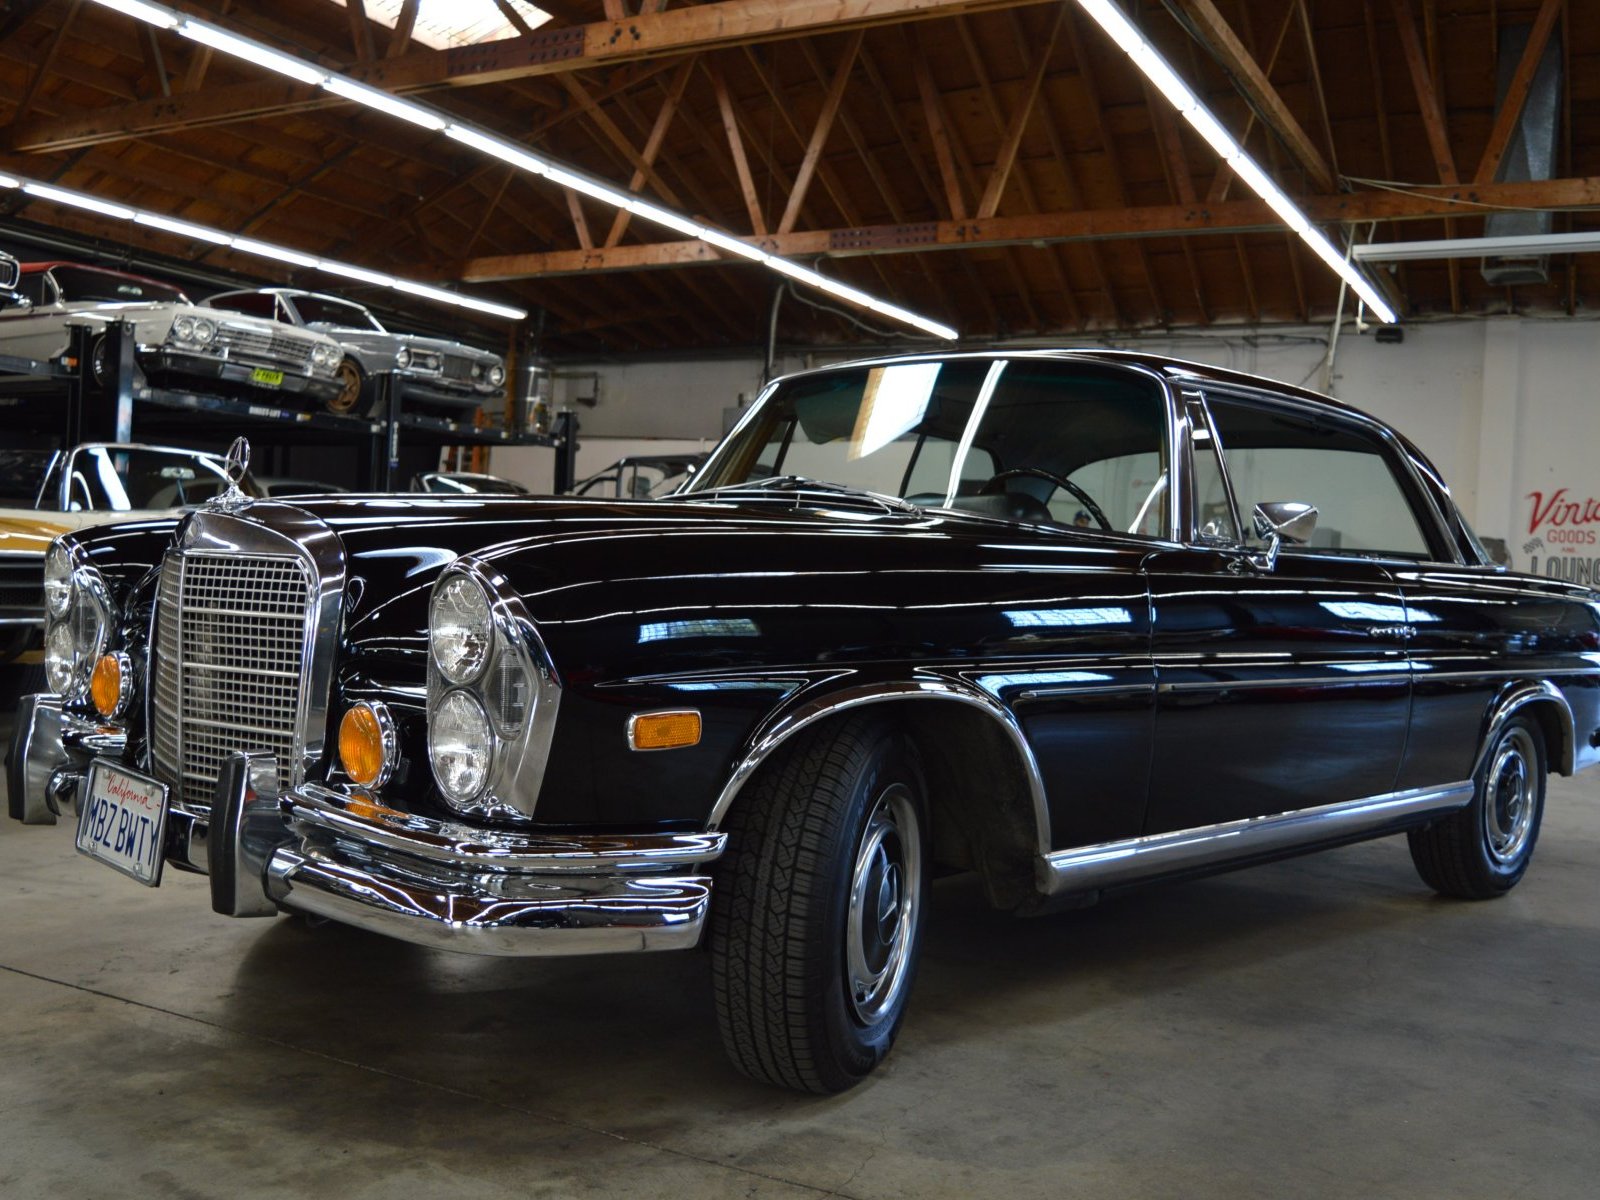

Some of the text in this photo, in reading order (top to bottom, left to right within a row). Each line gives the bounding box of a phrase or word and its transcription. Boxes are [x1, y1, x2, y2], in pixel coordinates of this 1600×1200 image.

[1547, 530, 1596, 544] GOODS
[107, 771, 152, 810] California
[84, 795, 160, 866] MBZ BWTY
